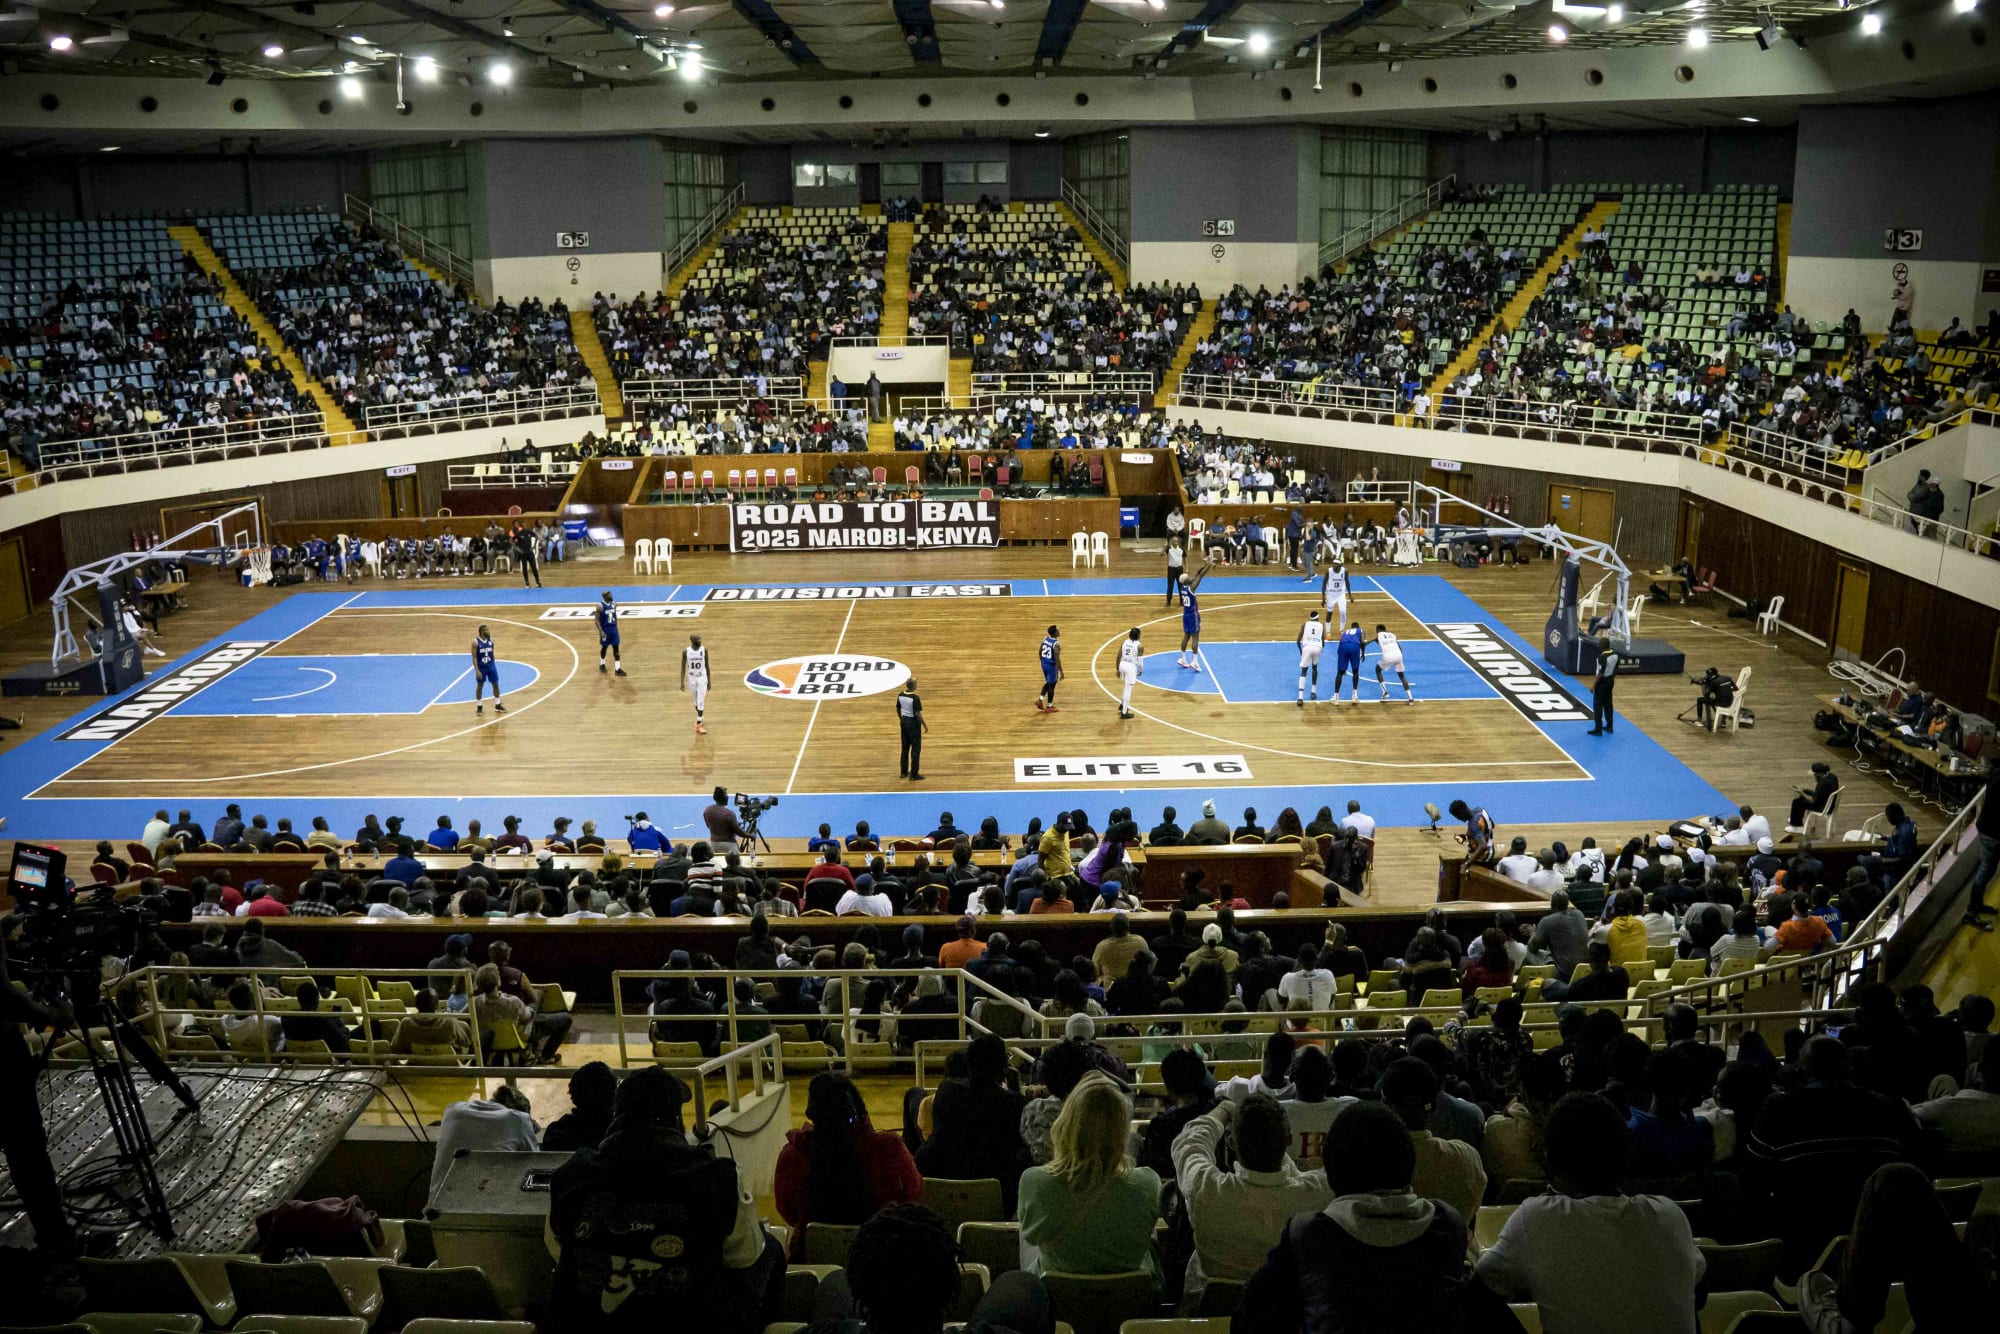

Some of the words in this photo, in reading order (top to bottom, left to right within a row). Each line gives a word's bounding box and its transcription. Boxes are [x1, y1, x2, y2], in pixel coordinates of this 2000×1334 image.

[1437, 461, 1455, 469] EXIT
[737, 503, 844, 525] ROAD
[858, 503, 906, 523] TO
[921, 502, 996, 522] BAL
[741, 529, 800, 548] 2025
[808, 526, 993, 547] NAIROBI-KENYA
[711, 586, 895, 600] DIVISION
[910, 584, 1006, 597] EAST
[658, 607, 697, 615] 16
[1041, 644, 1053, 660] 23
[690, 662, 701, 670] 10
[806, 661, 896, 672] ROAD
[1436, 623, 1589, 721] NAIROBI
[803, 672, 847, 682] TO
[66, 641, 270, 740] NAIROBI
[797, 683, 862, 694] BAL
[1023, 763, 1161, 776] ELITE
[1182, 761, 1243, 774] 16
